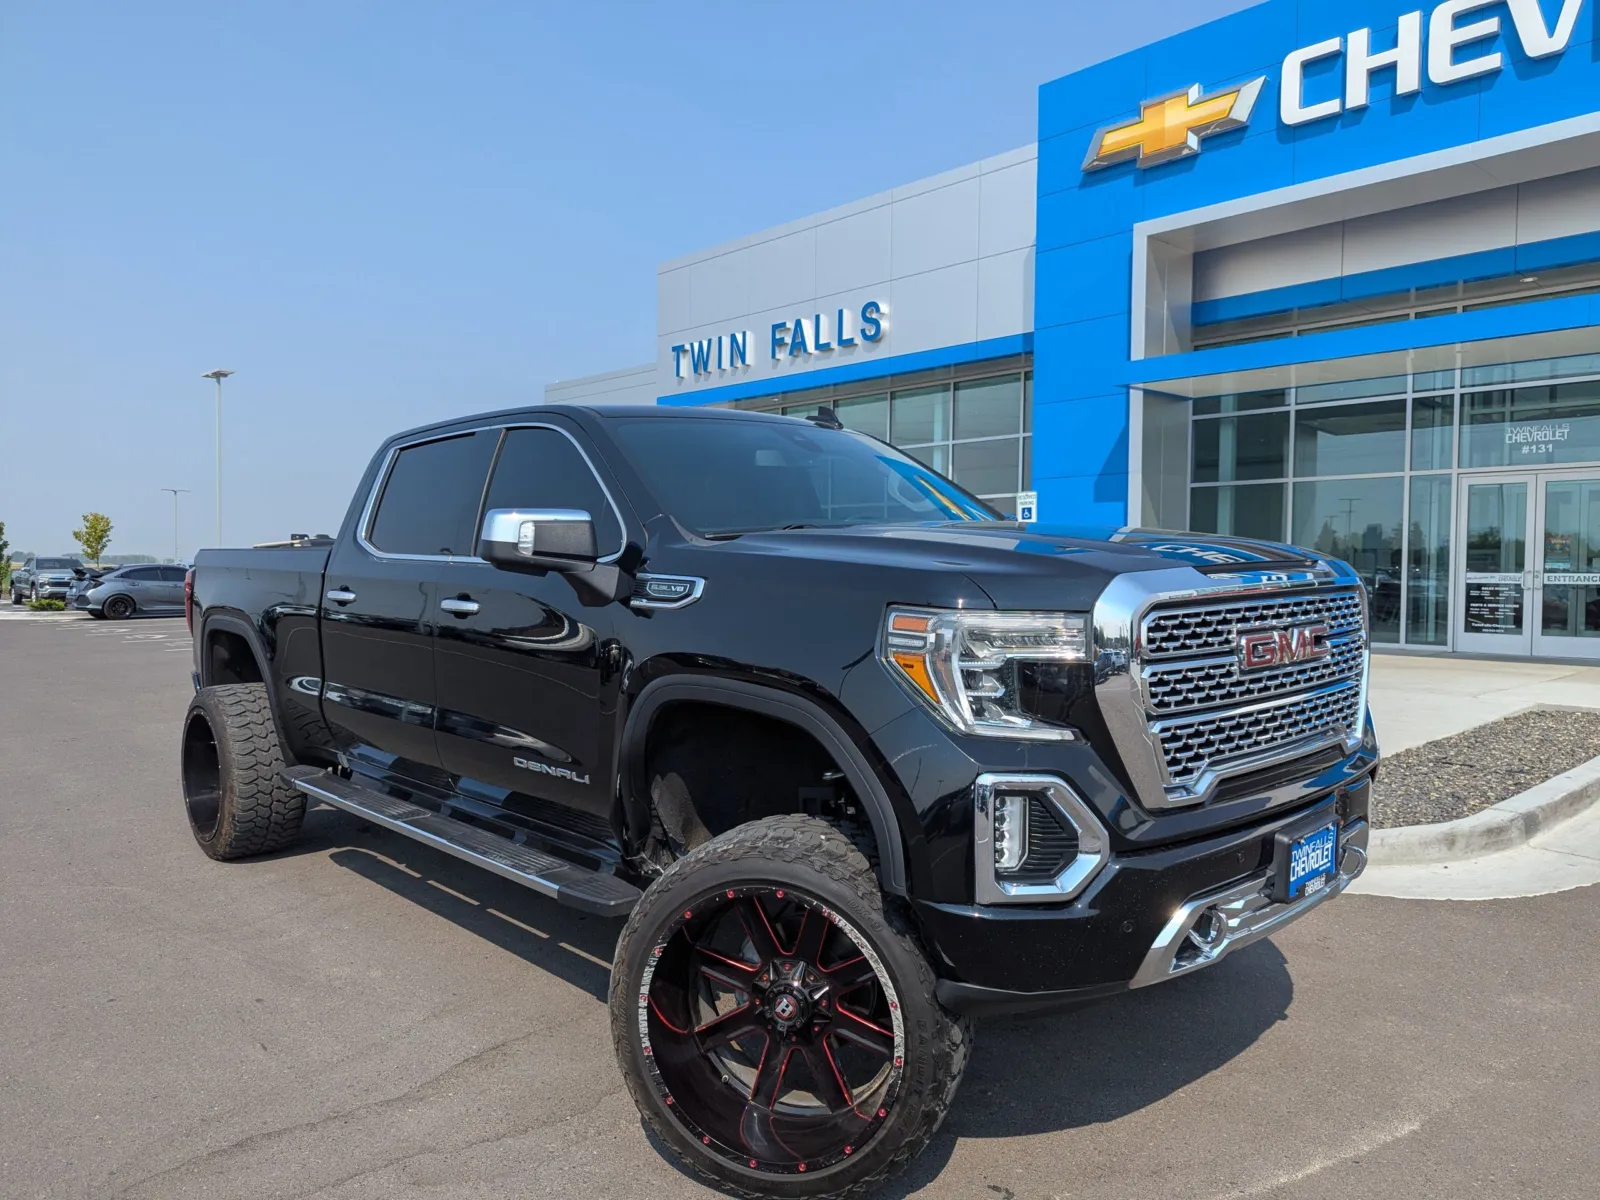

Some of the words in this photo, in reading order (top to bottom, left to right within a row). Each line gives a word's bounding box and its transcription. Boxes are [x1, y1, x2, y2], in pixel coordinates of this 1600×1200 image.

[1280, 0, 1584, 126] CHEV
[671, 331, 755, 379] TWIN
[770, 300, 890, 361] FALLS
[1505, 429, 1570, 444] CHEVROLET
[1522, 443, 1553, 454] #131
[1241, 625, 1331, 670] GMC
[513, 756, 590, 784] DENALI
[1290, 843, 1333, 882] CHEVROLET
